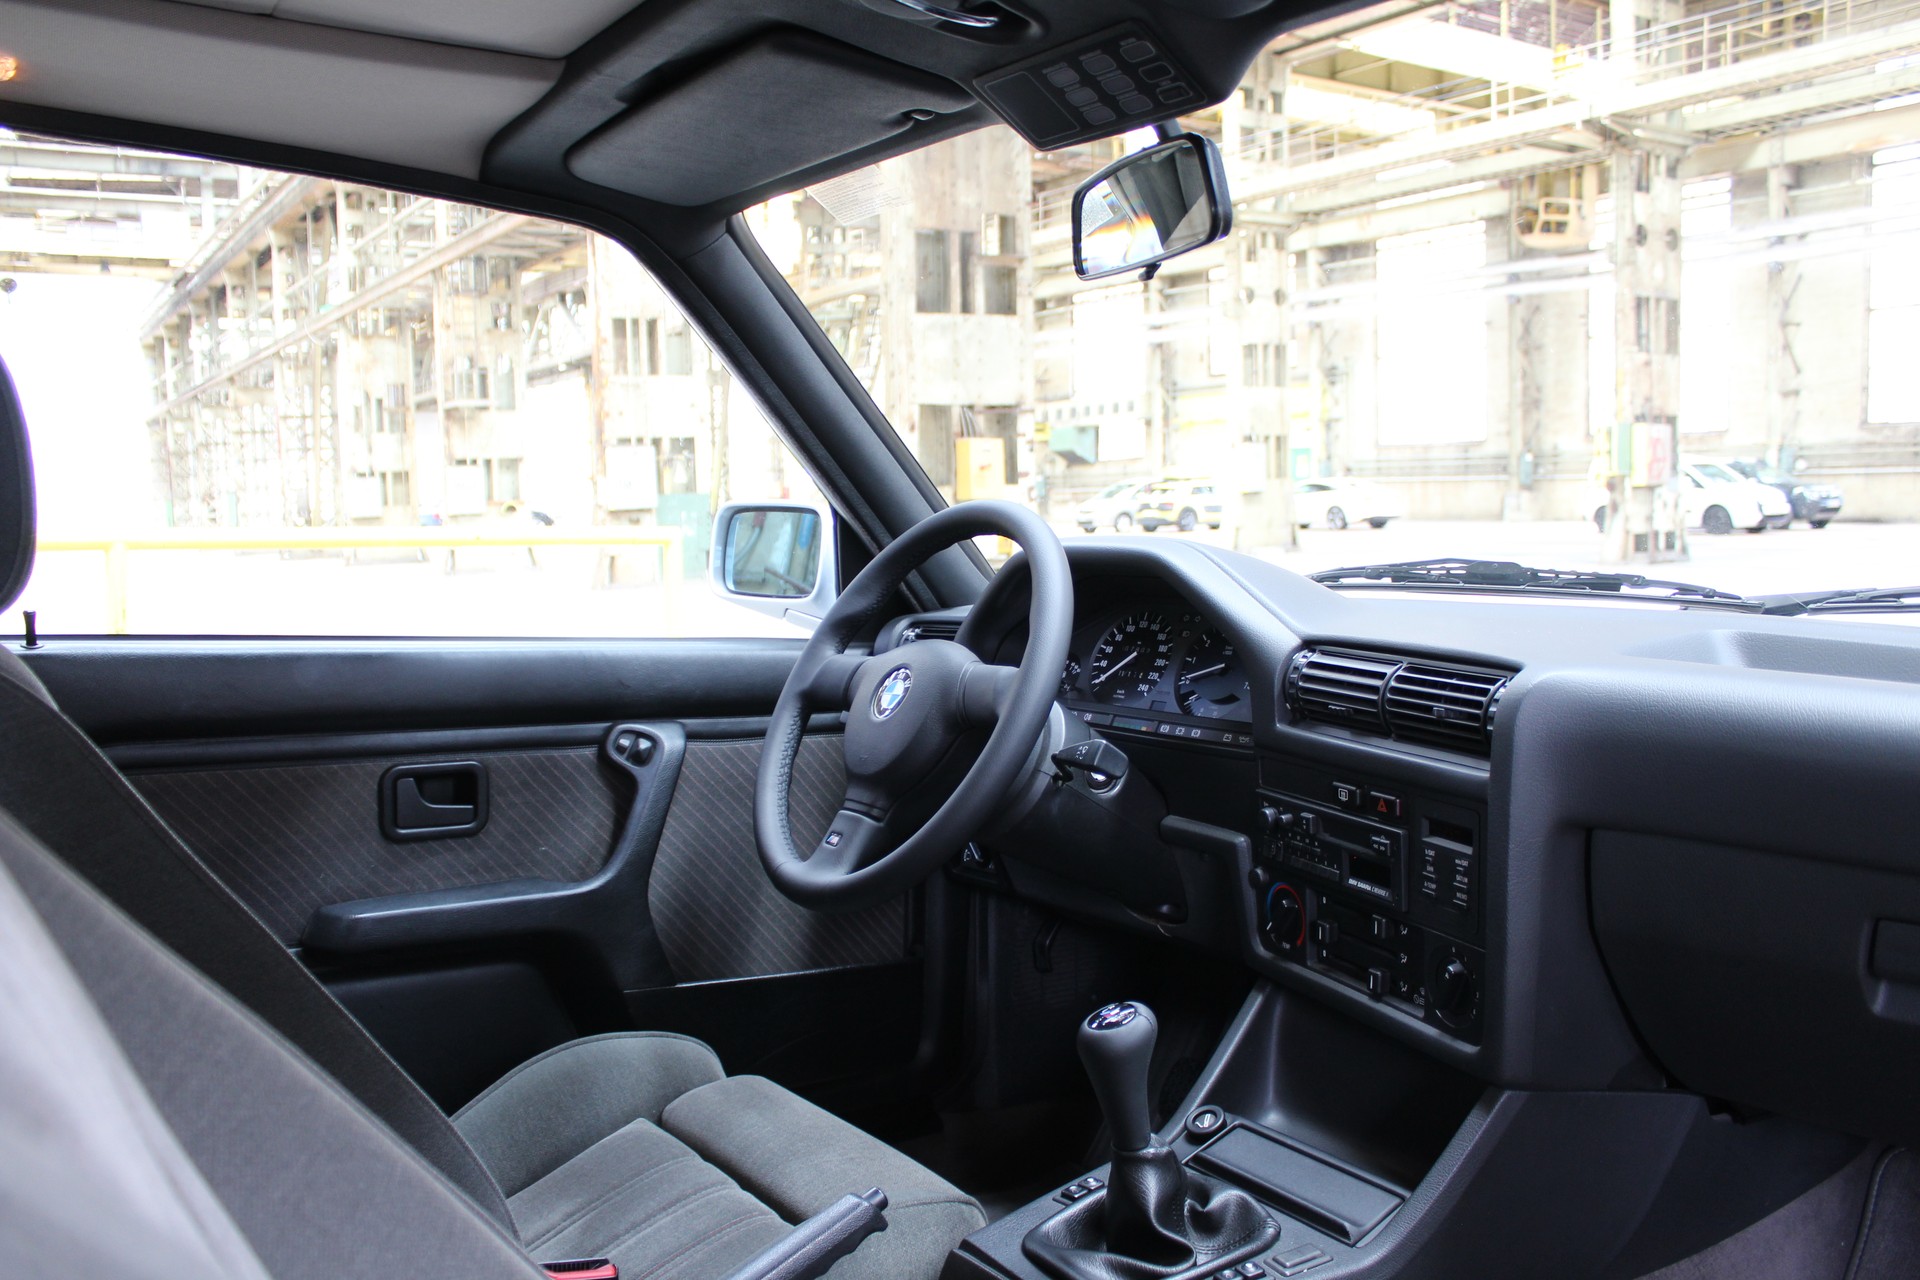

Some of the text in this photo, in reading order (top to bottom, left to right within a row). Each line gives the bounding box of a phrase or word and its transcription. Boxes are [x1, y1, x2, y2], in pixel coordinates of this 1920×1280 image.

[1150, 623, 1160, 631] 140
[1204, 640, 1211, 648] 2
[1154, 659, 1166, 667] 200
[1148, 672, 1159, 680] 220
